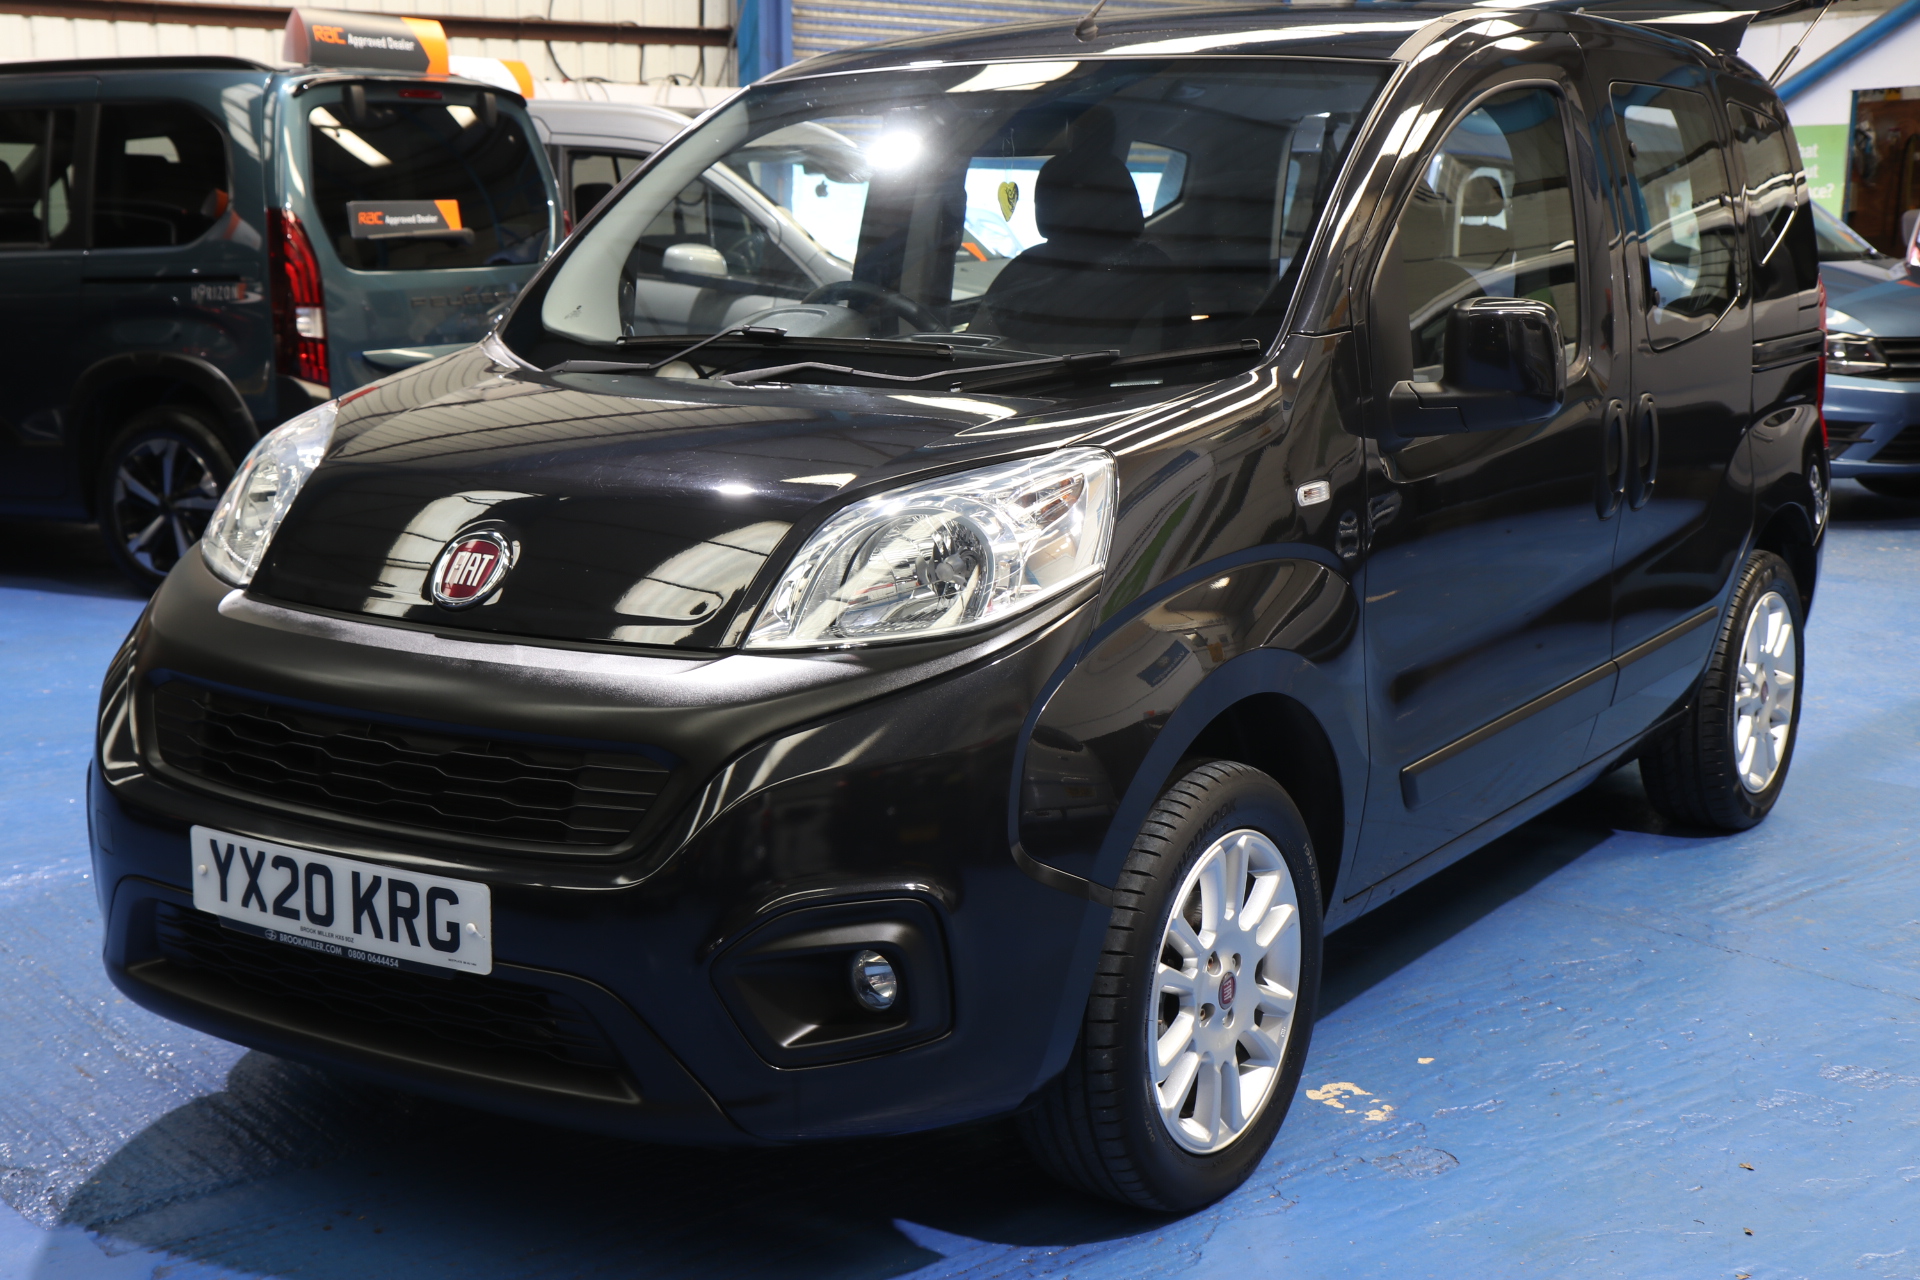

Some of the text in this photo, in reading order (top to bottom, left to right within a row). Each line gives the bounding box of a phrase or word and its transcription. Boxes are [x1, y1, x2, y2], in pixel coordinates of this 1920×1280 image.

[347, 33, 387, 50] Approved
[387, 36, 415, 52] Dealer
[385, 215, 416, 226] Approved
[416, 214, 438, 224] Dealer
[445, 551, 494, 587] FIAT
[209, 838, 461, 954] YX20 KRG
[300, 926, 316, 935] BROOK
[318, 930, 335, 939] MILLER
[280, 933, 399, 967] BROOKMILLER.COM 0800 0644454
[1223, 979, 1232, 1001] FIAT
